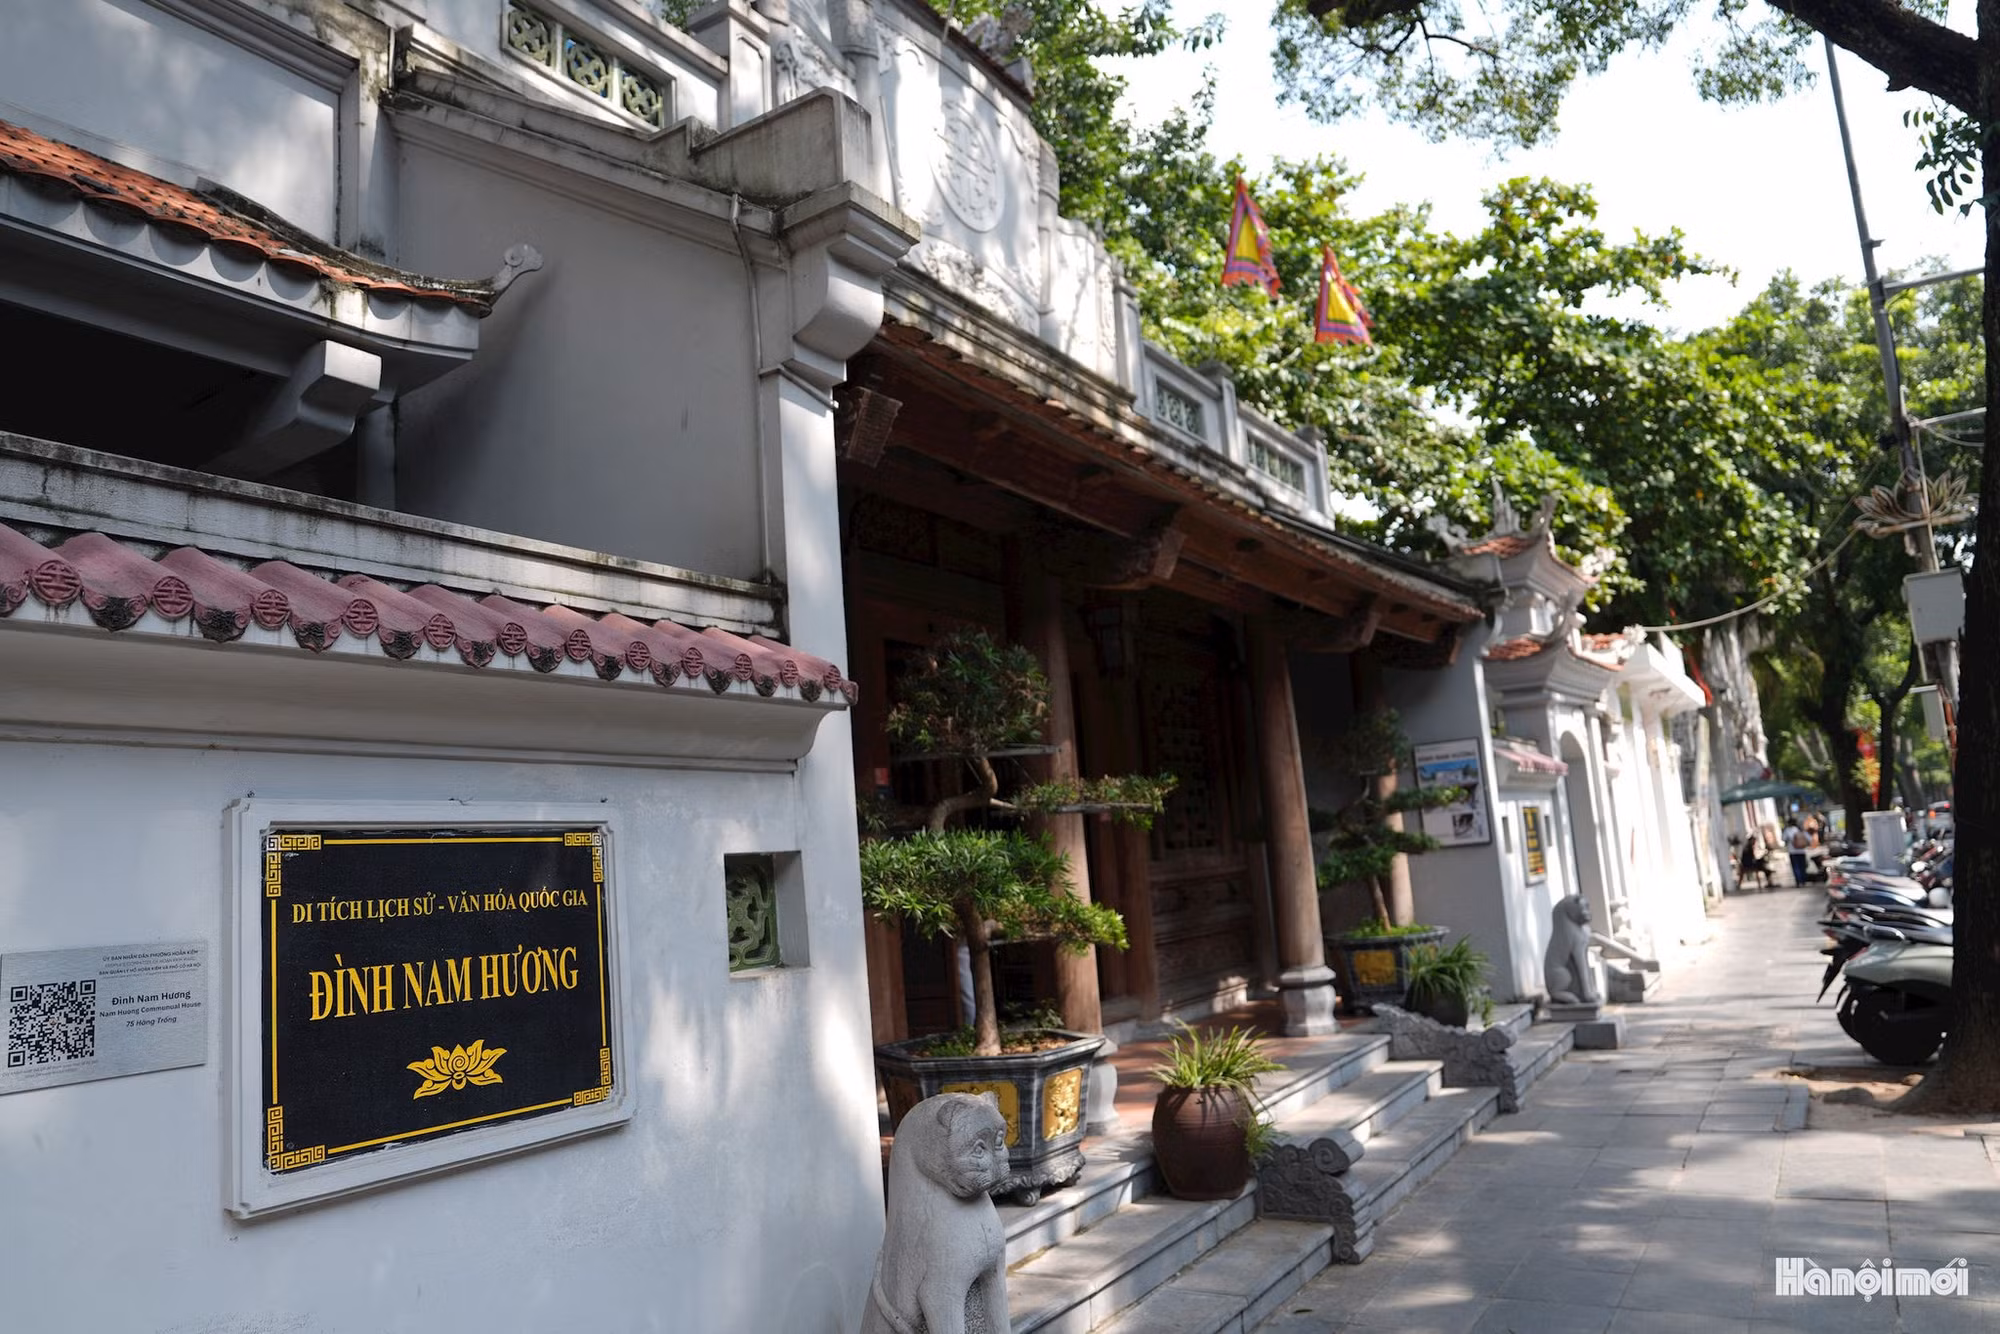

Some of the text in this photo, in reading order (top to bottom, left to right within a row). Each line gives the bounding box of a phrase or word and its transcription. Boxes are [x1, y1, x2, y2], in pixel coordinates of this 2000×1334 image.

[292, 903, 313, 923] DI
[317, 896, 362, 922] TÍCH
[367, 898, 410, 923] LỊCH
[414, 891, 436, 916] SỬ
[447, 890, 480, 913] VĂN
[484, 888, 517, 911] HÓA
[519, 886, 560, 913] QUỐC
[562, 890, 588, 907] GIA
[112, 991, 191, 1005] Đình Nam Hương
[309, 944, 579, 1021] ĐÌNH NAM HƯƠNG
